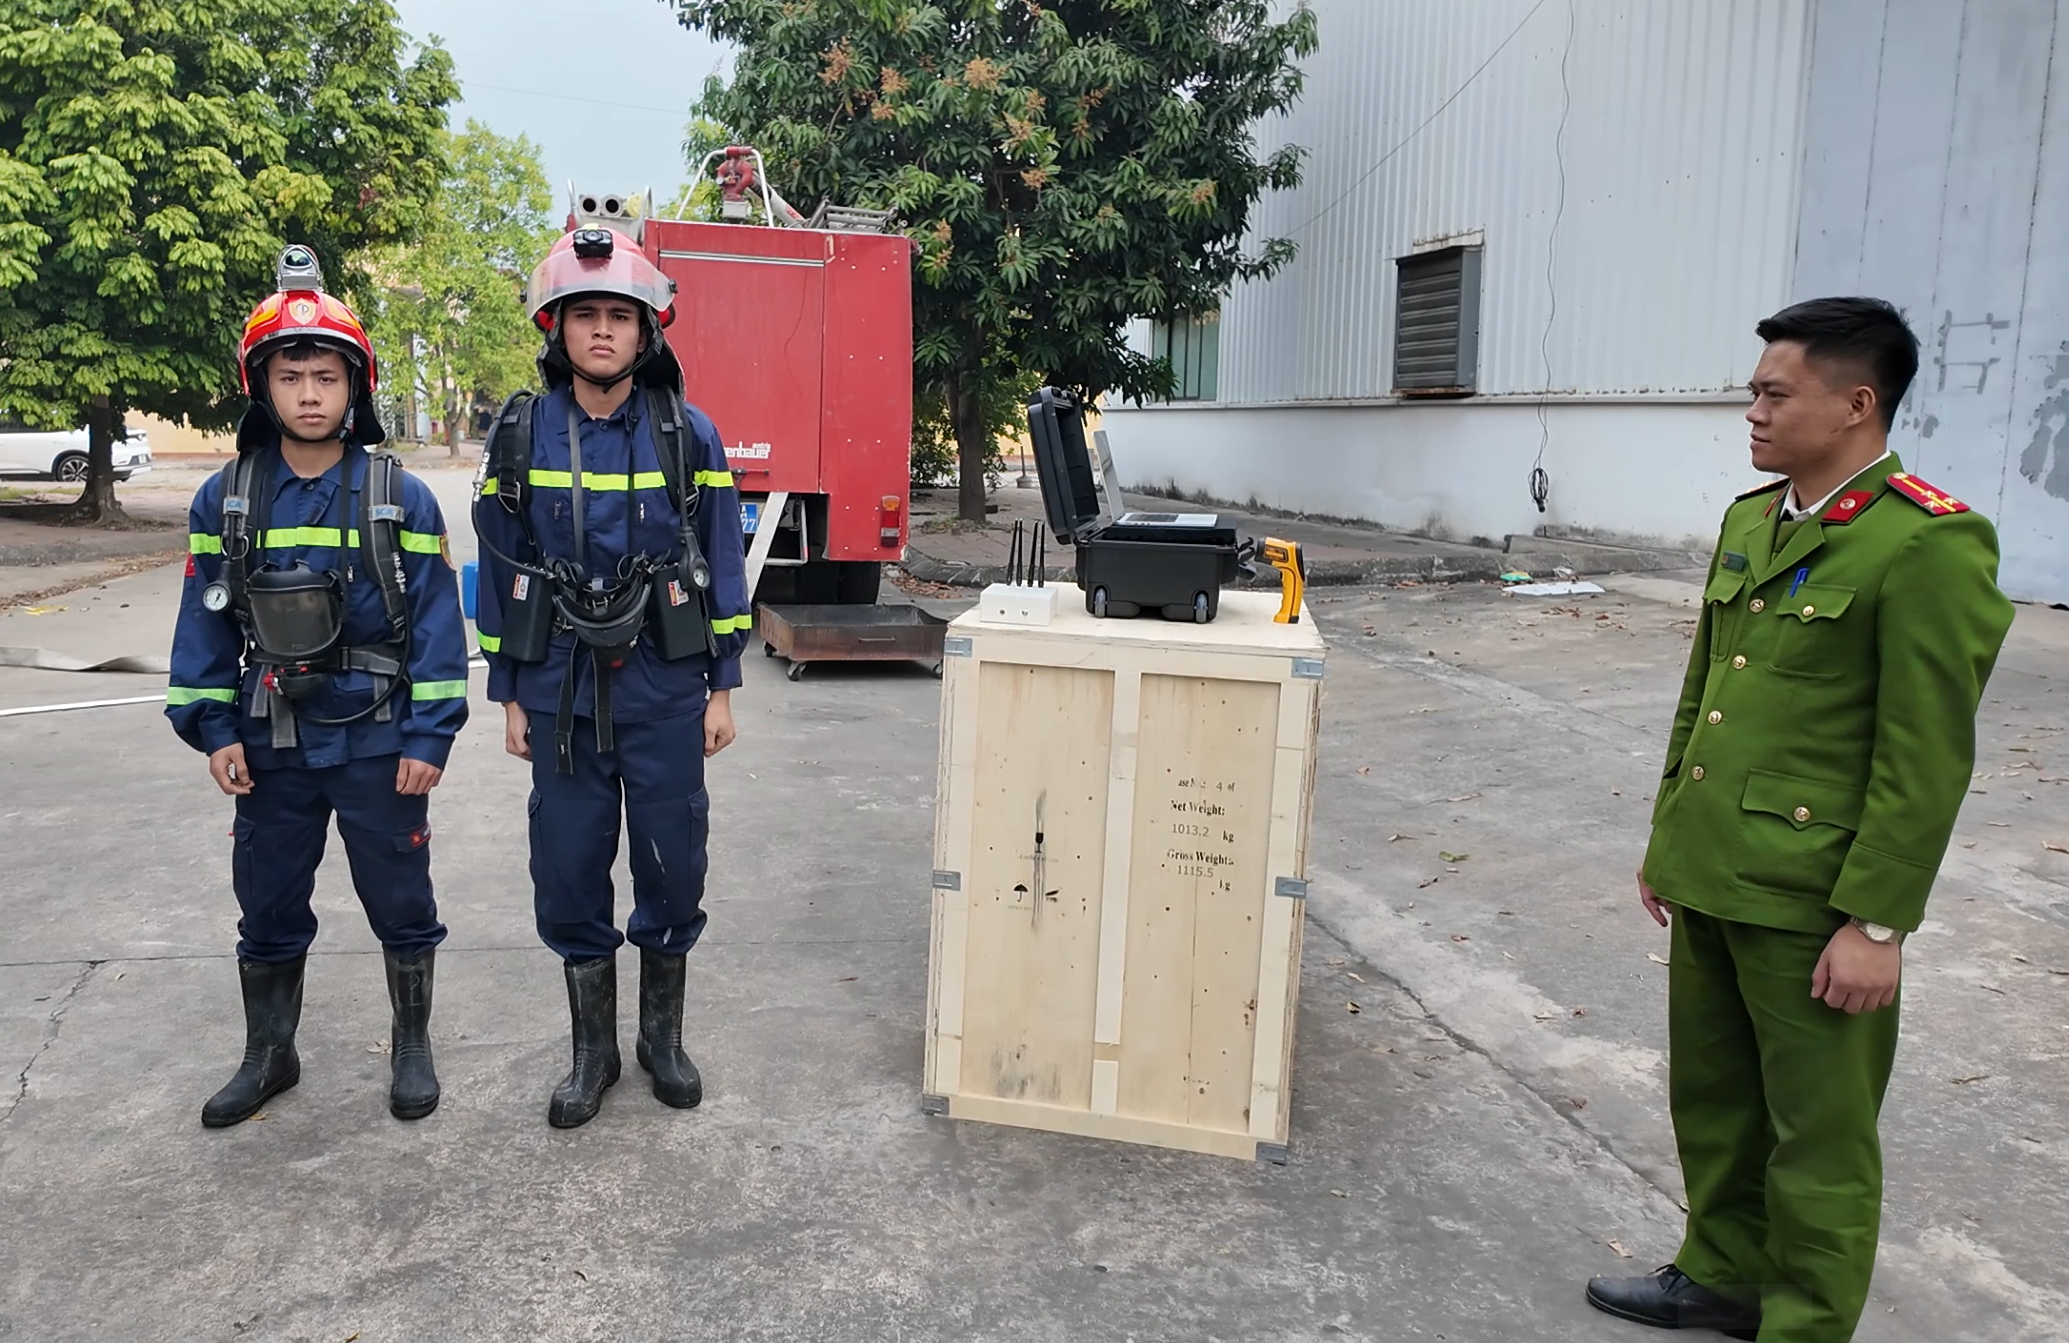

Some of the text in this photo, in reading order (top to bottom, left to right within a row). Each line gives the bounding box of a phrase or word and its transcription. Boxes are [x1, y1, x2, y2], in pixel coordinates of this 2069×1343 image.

[724, 441, 770, 459] enbauer
[1177, 779, 1190, 788] ase
[1215, 781, 1223, 792] 4
[1189, 799, 1226, 817] Weight:
[1172, 823, 1235, 844] 1013.2 kg
[1167, 848, 1194, 861] Gross
[1177, 864, 1214, 878] 1115.5
